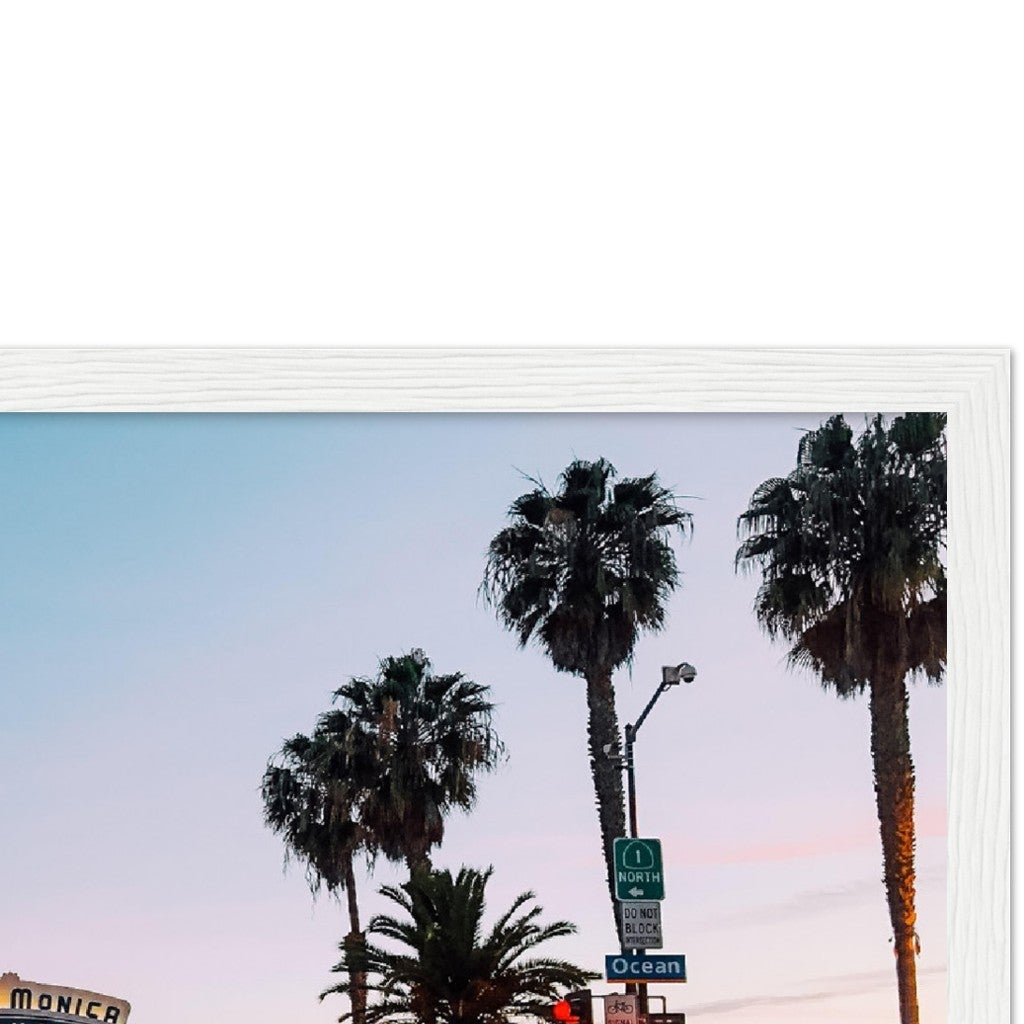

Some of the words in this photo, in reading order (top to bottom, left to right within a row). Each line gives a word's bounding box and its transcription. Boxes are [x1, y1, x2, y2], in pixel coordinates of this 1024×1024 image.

[635, 849, 641, 864] 1
[618, 871, 661, 883] NORTH
[624, 908, 637, 919] DO
[639, 908, 658, 919] NOT
[625, 923, 660, 934] BLOCK
[611, 958, 681, 974] Ocean
[10, 988, 121, 1024] MONICA
